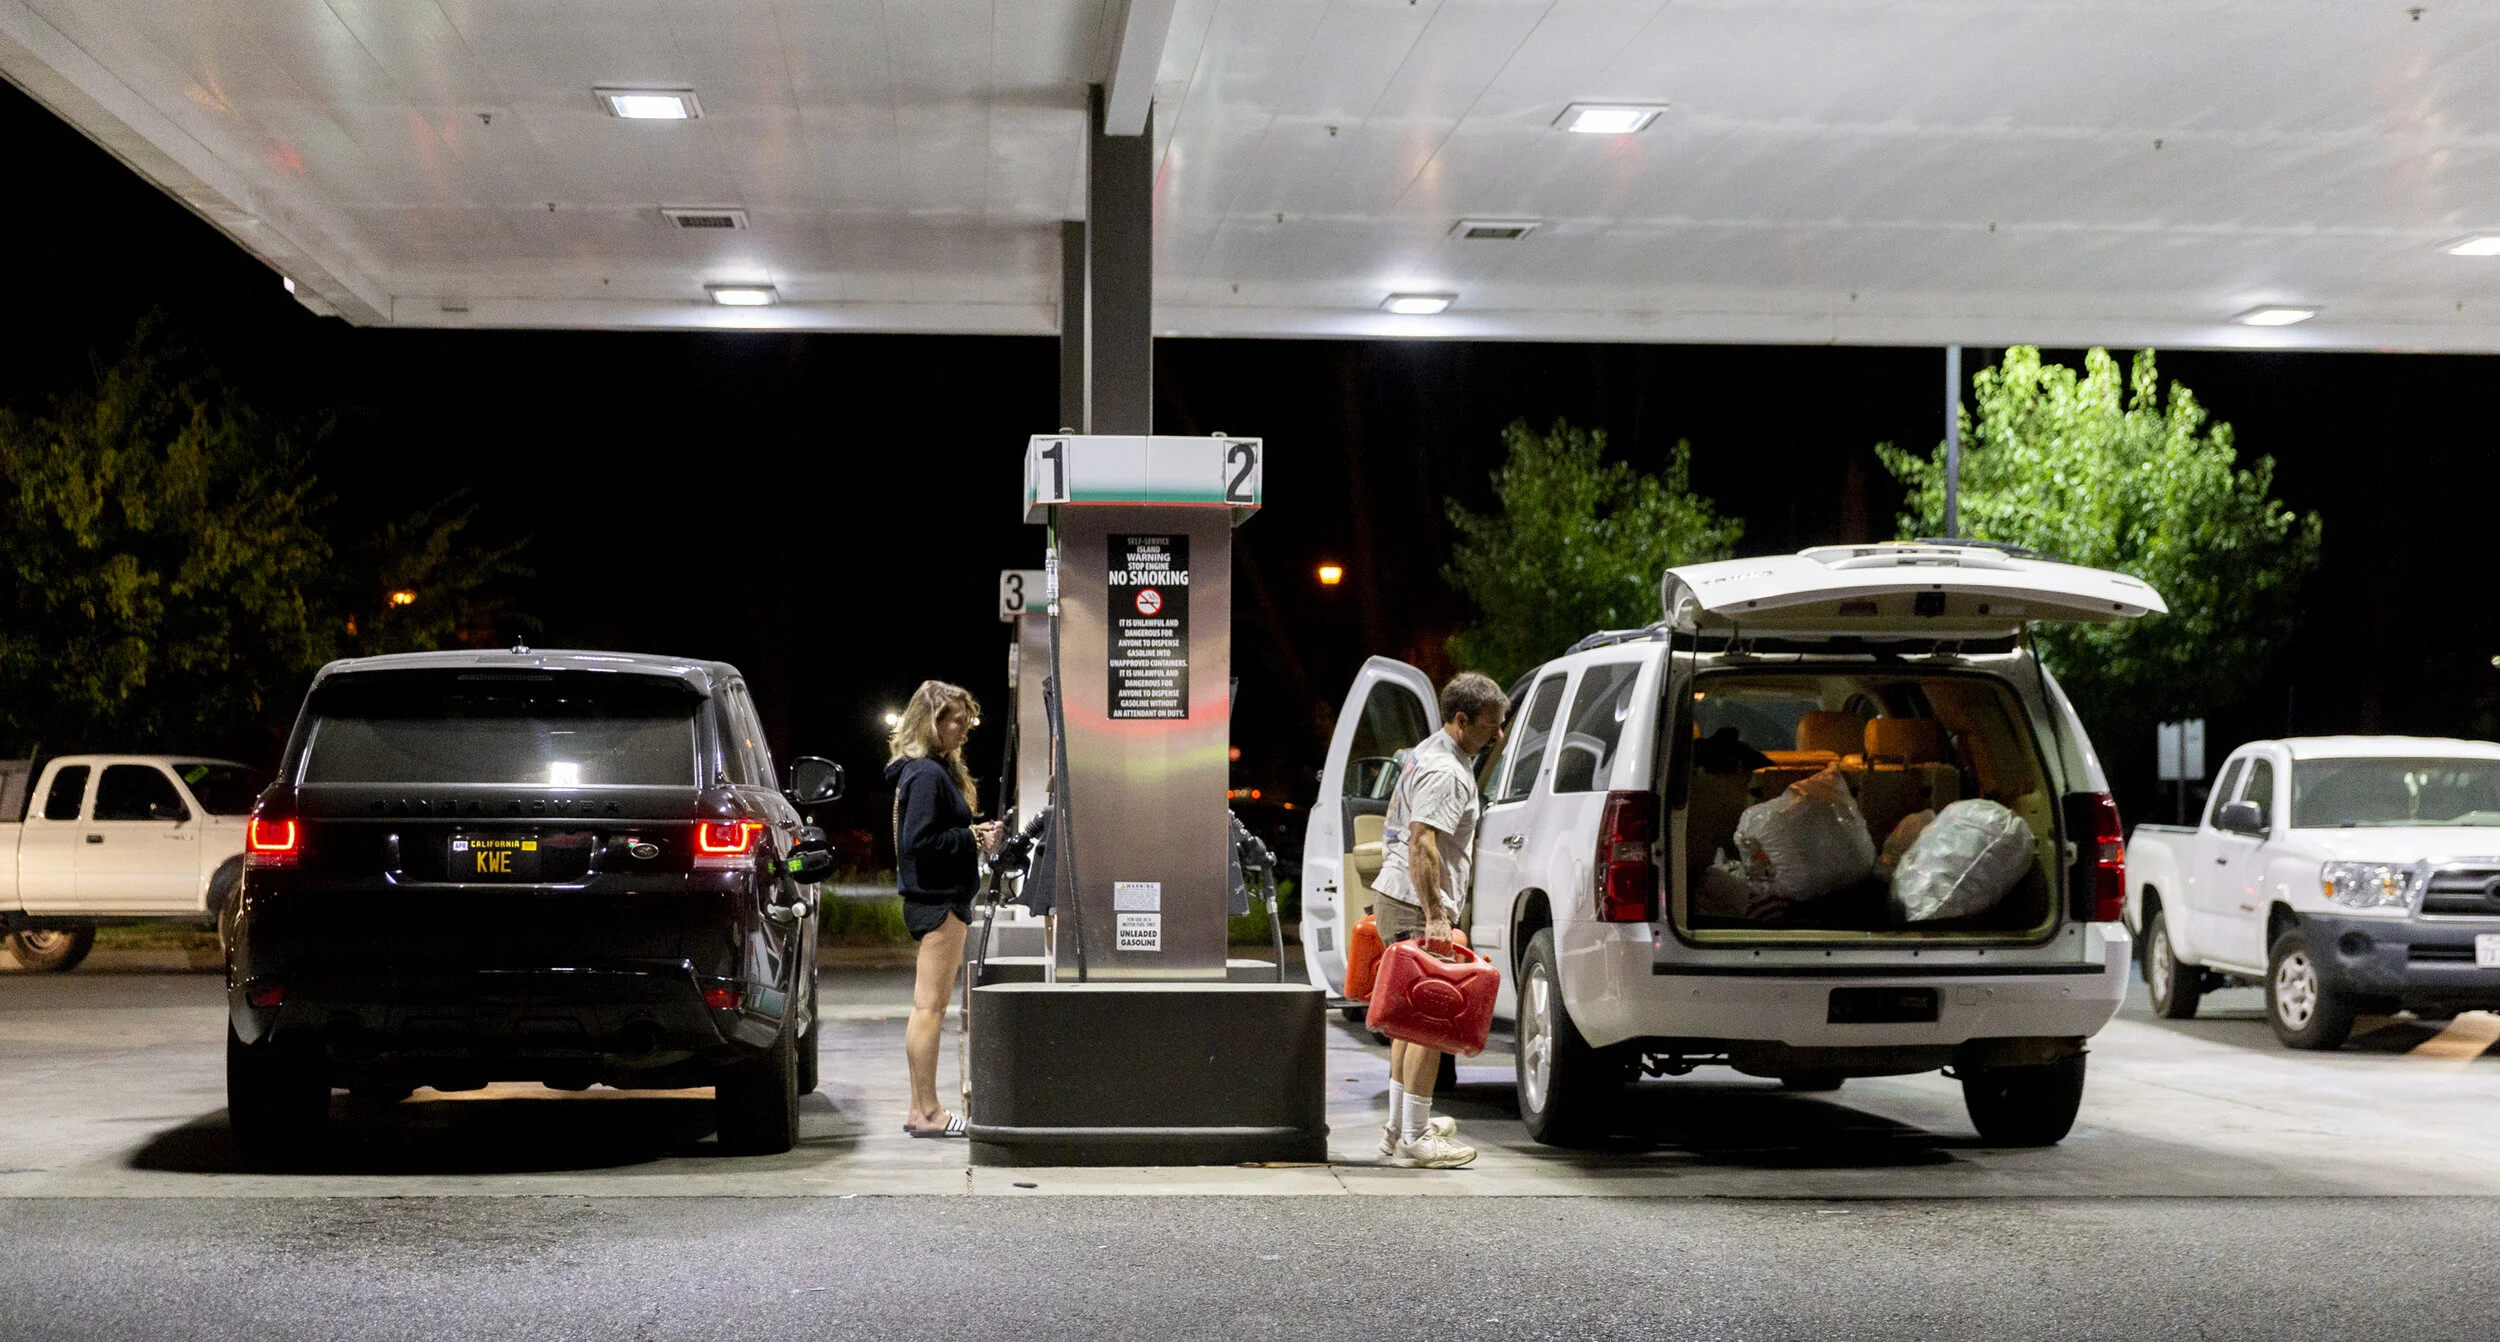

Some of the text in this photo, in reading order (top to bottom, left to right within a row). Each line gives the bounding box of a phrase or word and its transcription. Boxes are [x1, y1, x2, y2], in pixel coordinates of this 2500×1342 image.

[1042, 441, 1063, 500] 1
[1227, 443, 1255, 503] 2
[1127, 537, 1170, 545] SELF-SERVICE
[1126, 553, 1171, 562] WARNING
[1127, 562, 1170, 570] STOP ENGINE
[1109, 570, 1189, 586] NO SMOKING
[1006, 573, 1024, 611] 3
[1119, 619, 1179, 627] IT IS UNLAWFUL AND
[1125, 629, 1173, 637] DANGEROUS FOR
[1118, 639, 1179, 647] ANYONE TO DISPENSE
[1127, 649, 1171, 657] GASOLINE INTO
[1109, 659, 1188, 667] UNAPPROVED CONTAINERS.
[1119, 669, 1179, 677] IT IS UNLAWFUL AND
[1125, 679, 1173, 687] DANGEROUS FOR
[1118, 689, 1179, 697] ANYONE TO DISPENSE
[1120, 699, 1178, 707] GASOLINE WITHOUT
[1113, 709, 1185, 717] AN ATTENDANT ON DUTY.
[470, 840, 520, 848] CALIFORNIA
[477, 851, 512, 873] KWE
[1120, 930, 1157, 938] UNLEADED
[1121, 939, 1156, 947] GASOLINE
